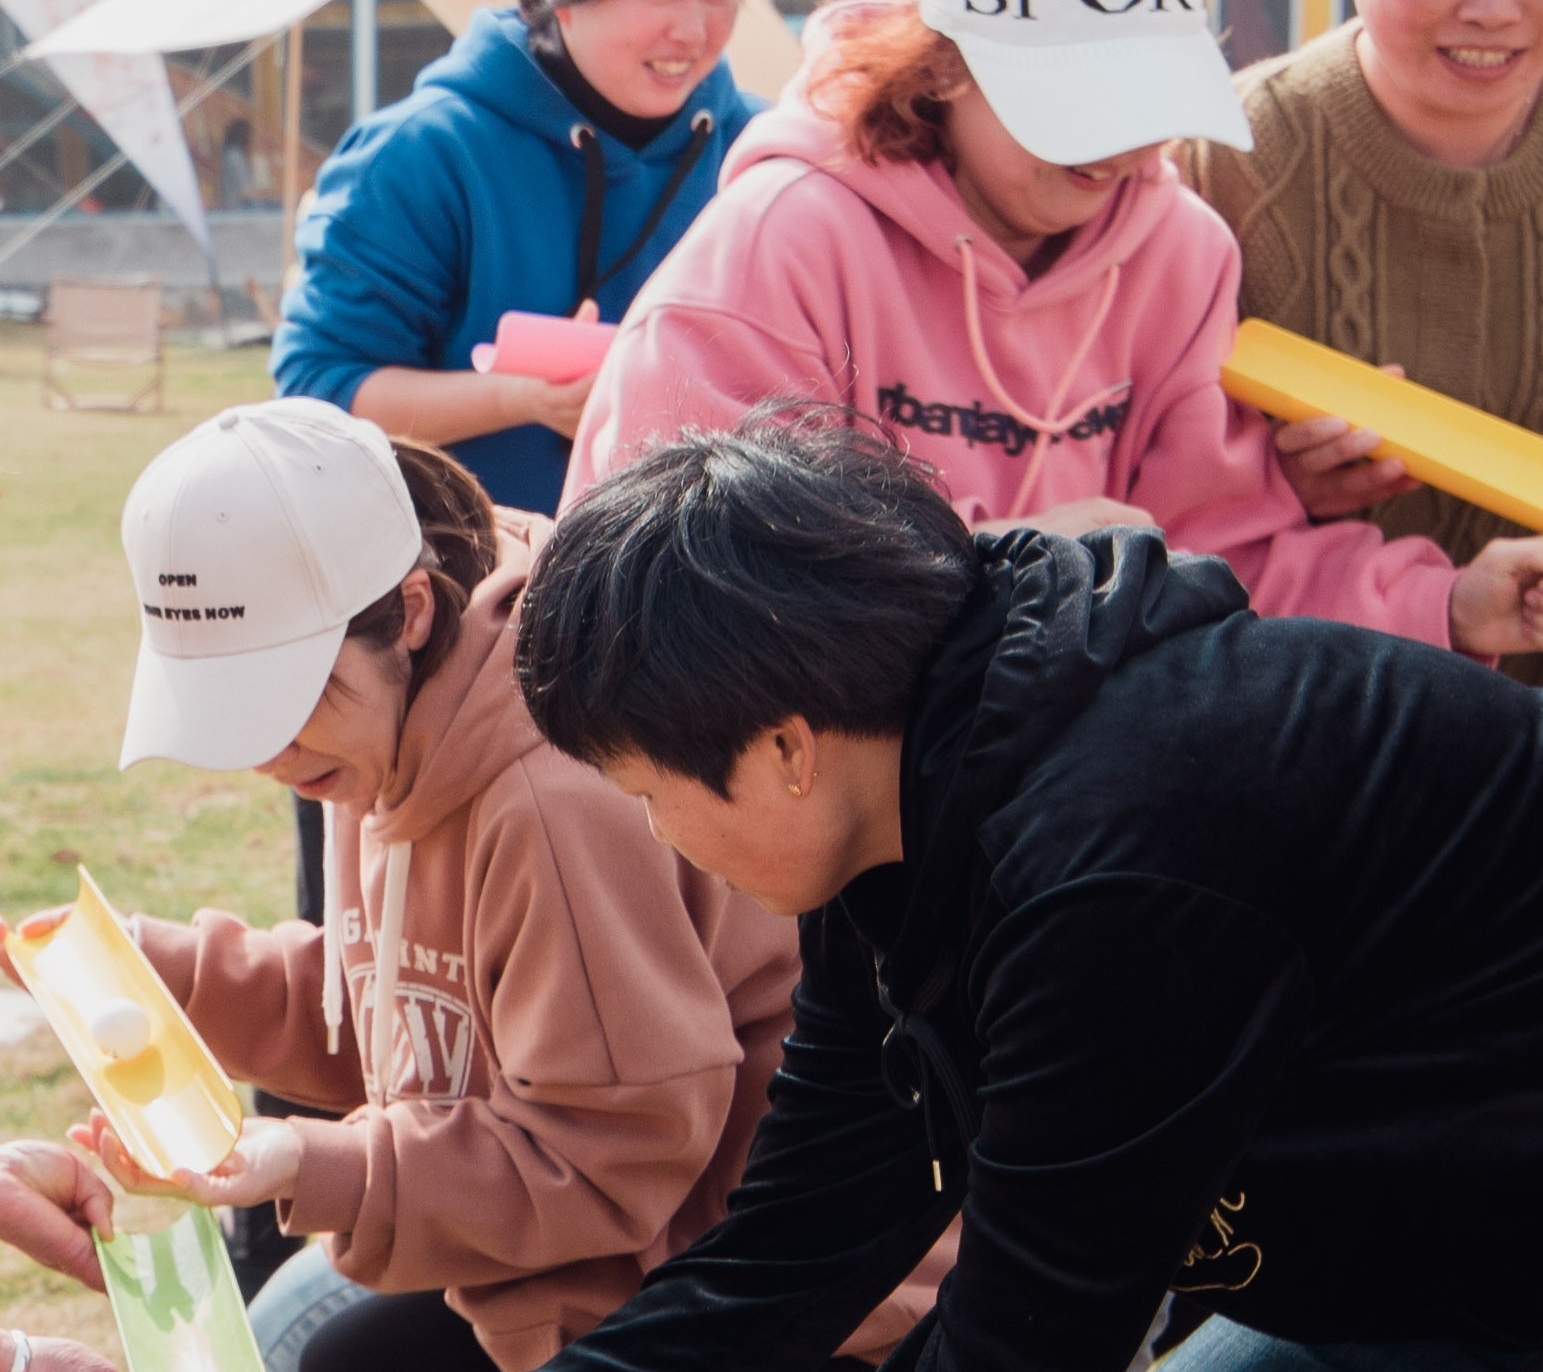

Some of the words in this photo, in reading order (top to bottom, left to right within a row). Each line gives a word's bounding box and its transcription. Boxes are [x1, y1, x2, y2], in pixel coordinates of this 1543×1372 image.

[158, 573, 197, 587] OPEN
[164, 607, 202, 621] EYES
[204, 605, 246, 621] NOW
